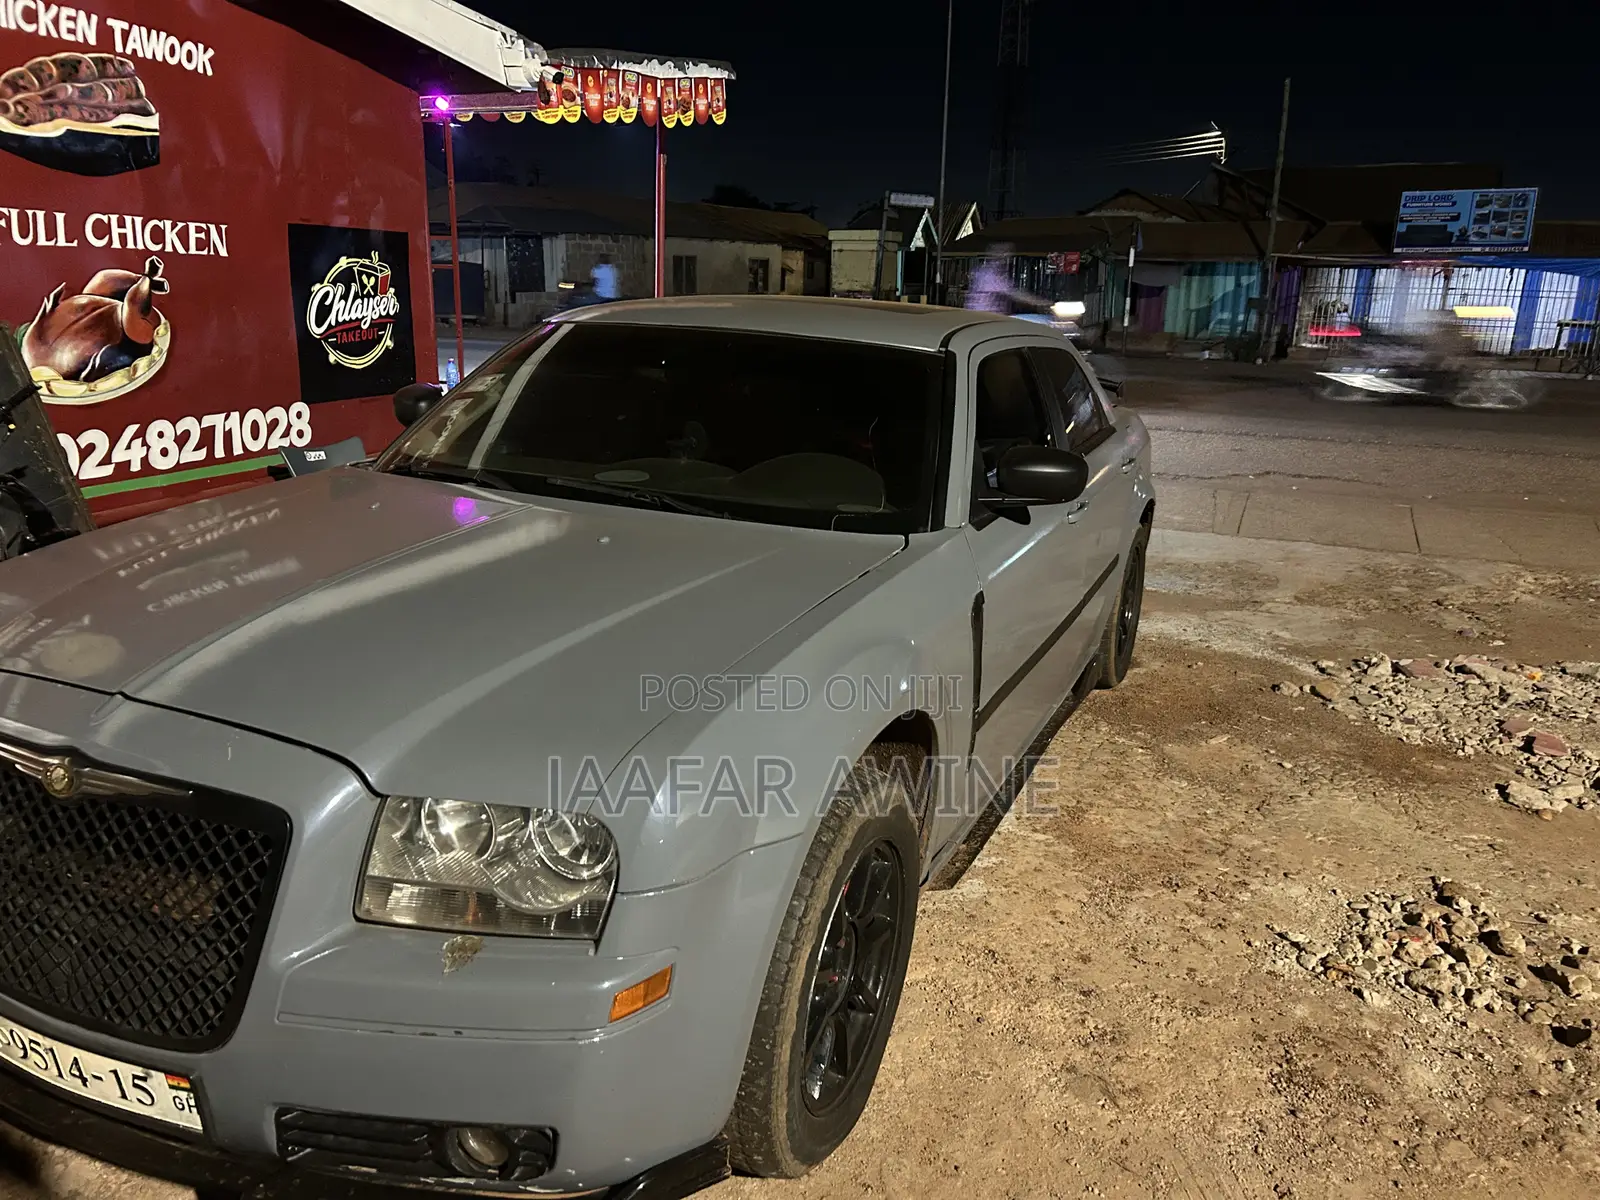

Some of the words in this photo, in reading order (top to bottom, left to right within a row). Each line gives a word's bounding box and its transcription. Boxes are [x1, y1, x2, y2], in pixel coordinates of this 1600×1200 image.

[106, 17, 215, 77] TAWOOK
[85, 212, 230, 258] CHICKEN
[308, 282, 399, 335] Chlayser
[336, 328, 379, 344] TAKEOUT
